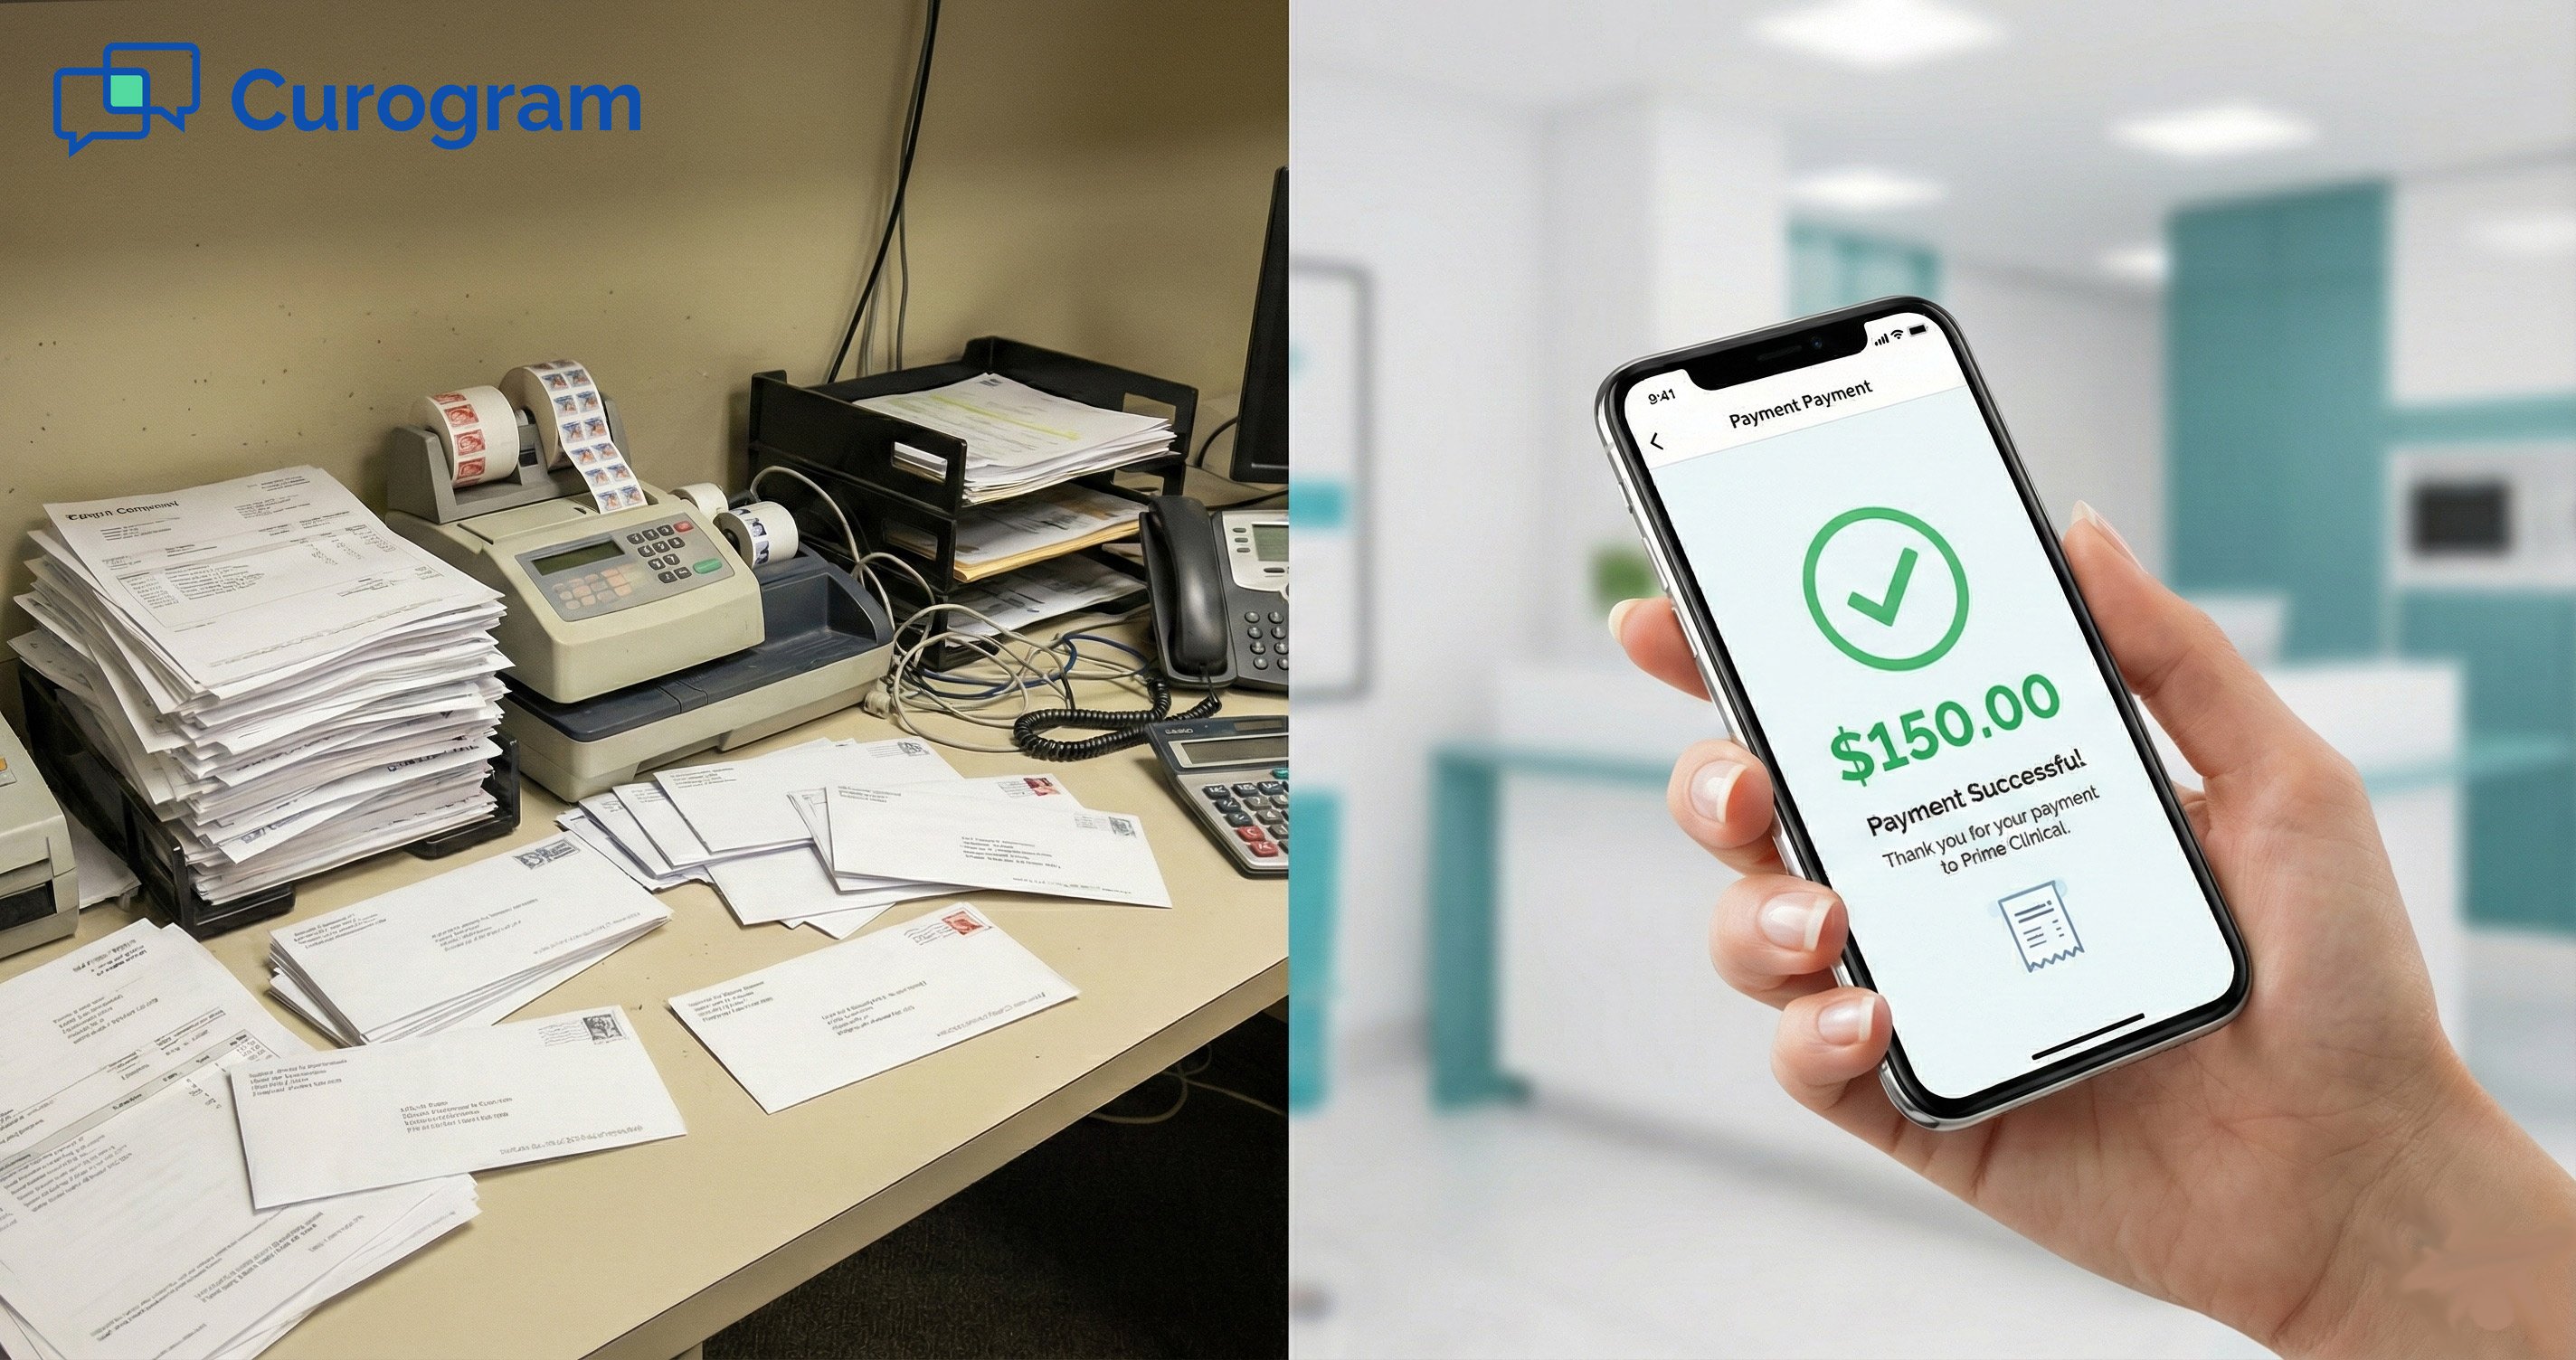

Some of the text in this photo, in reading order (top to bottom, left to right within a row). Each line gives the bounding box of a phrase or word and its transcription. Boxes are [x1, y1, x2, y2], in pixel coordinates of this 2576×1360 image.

[1647, 388, 1676, 405] 9:41
[1728, 380, 1873, 429] Payment Payment
[1830, 673, 2061, 788] $150.00
[1866, 789, 1967, 837] Payment
[1881, 785, 2100, 868] Thank you for your payment
[1940, 860, 1959, 875] to
[1960, 844, 2007, 868] Prime
